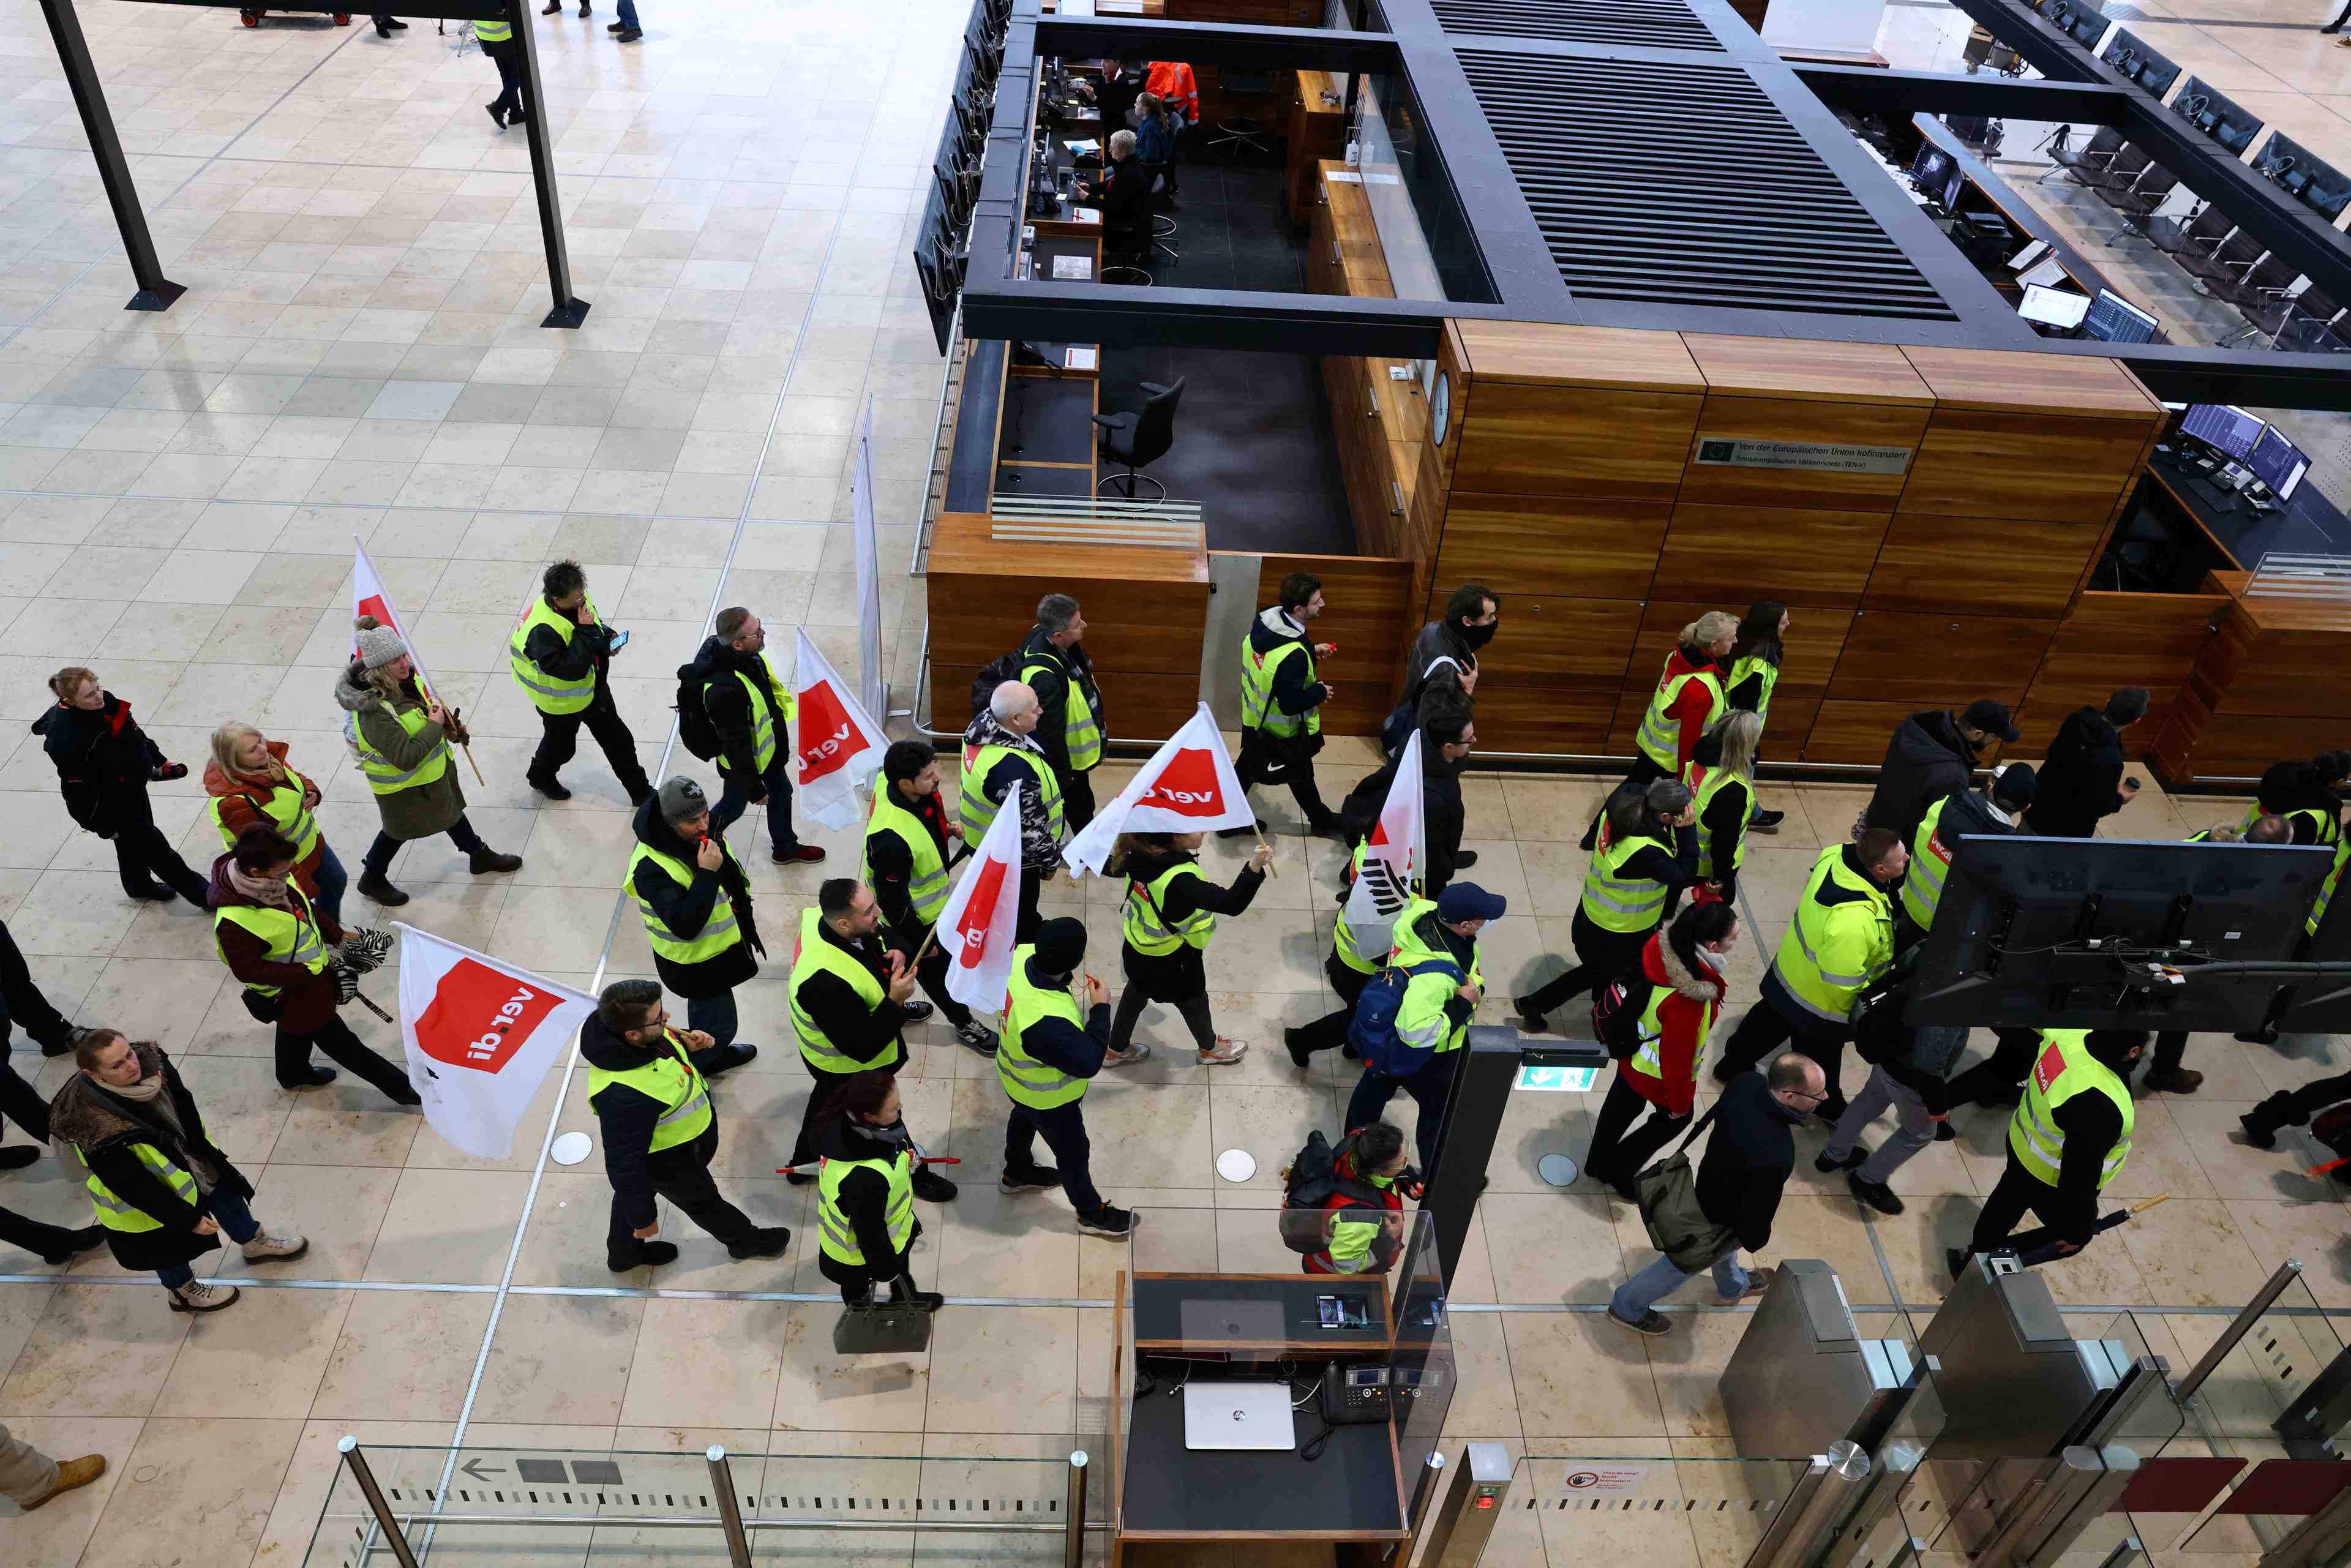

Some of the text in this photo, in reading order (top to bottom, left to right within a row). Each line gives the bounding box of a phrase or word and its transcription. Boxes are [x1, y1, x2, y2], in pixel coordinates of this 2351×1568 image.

[1739, 442, 1754, 451] Von
[1772, 445, 1829, 456] Europäischen
[1831, 448, 1854, 457] Union
[1856, 449, 1907, 459] kofinanziert
